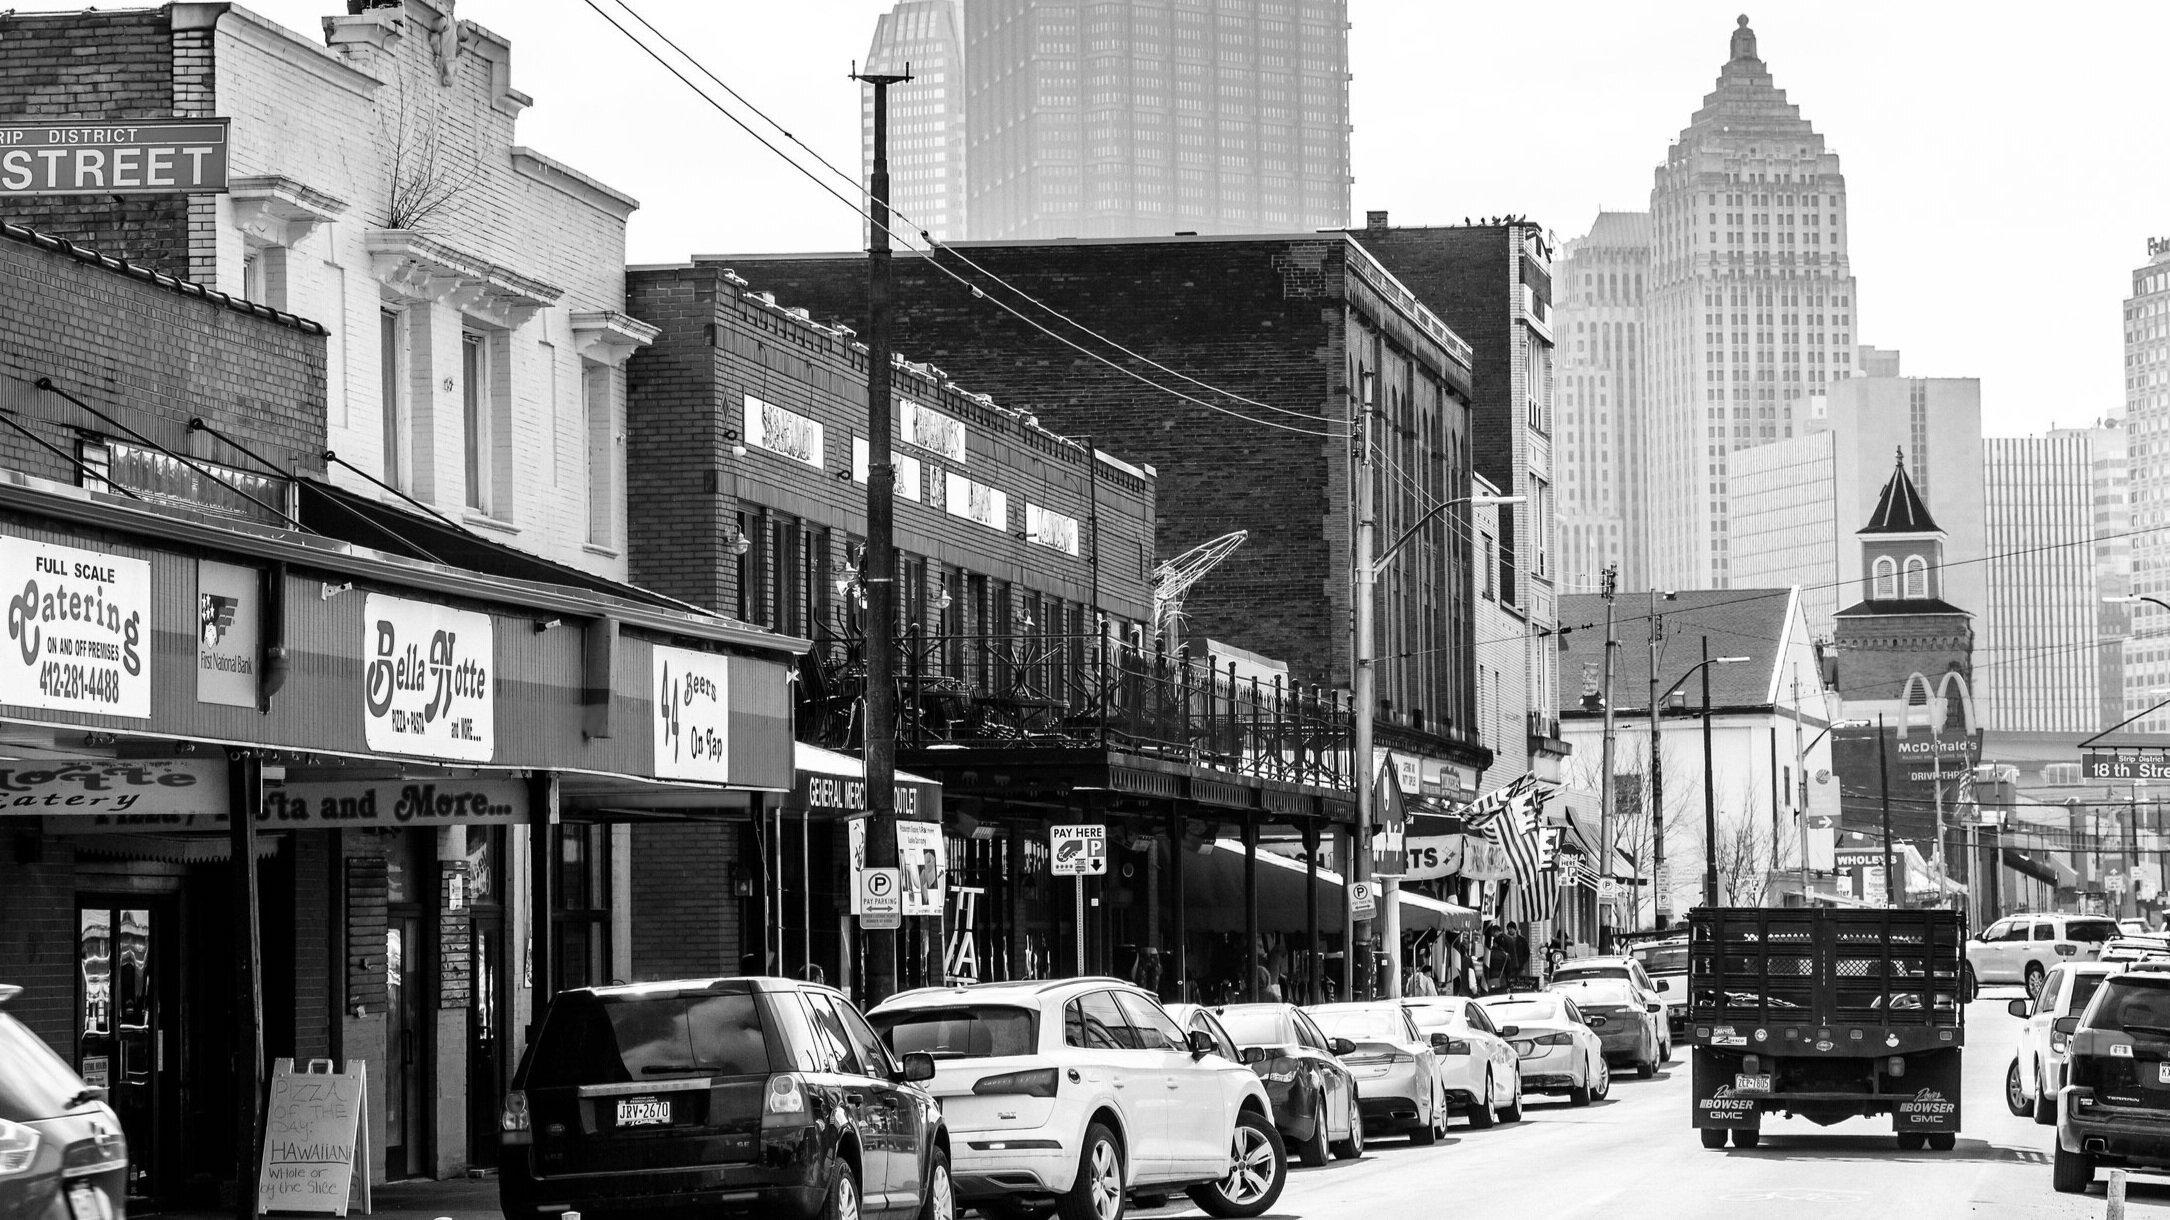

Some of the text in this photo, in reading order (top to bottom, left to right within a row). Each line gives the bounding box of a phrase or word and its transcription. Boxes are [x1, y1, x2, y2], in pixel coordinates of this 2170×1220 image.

[50, 129, 138, 143] DISTRICT
[2, 147, 213, 190] STREET
[36, 557, 115, 584] FULL SCALE
[9, 579, 140, 677] Catering
[47, 637, 119, 661] ON AND OFF PREMISES
[201, 651, 253, 675] First National Bank
[366, 620, 485, 723] Bella Notte
[40, 661, 119, 704] 412-281-4488
[392, 709, 425, 735] PIZZA PASTA
[662, 660, 717, 764] 44 Beers
[691, 726, 722, 763] On Tap
[2119, 755, 2136, 763] Strip
[2092, 763, 2110, 777] 18
[2114, 763, 2131, 777] th
[320, 788, 377, 820] and
[810, 777, 843, 808] GENERAL
[894, 786, 917, 815] OUTLET
[1053, 827, 1102, 838] PAY HERE
[864, 897, 897, 906] PAY PARKING
[275, 1080, 344, 1101] PIZZA
[274, 1104, 348, 1120] OF THE
[1705, 1100, 1754, 1110] BOWSER
[1710, 1111, 1743, 1119] GMC
[1905, 1102, 1955, 1113] BOWSER
[1910, 1115, 1944, 1123] GMC
[310, 1169, 327, 1179] or
[260, 1180, 338, 1200] by the Slice
